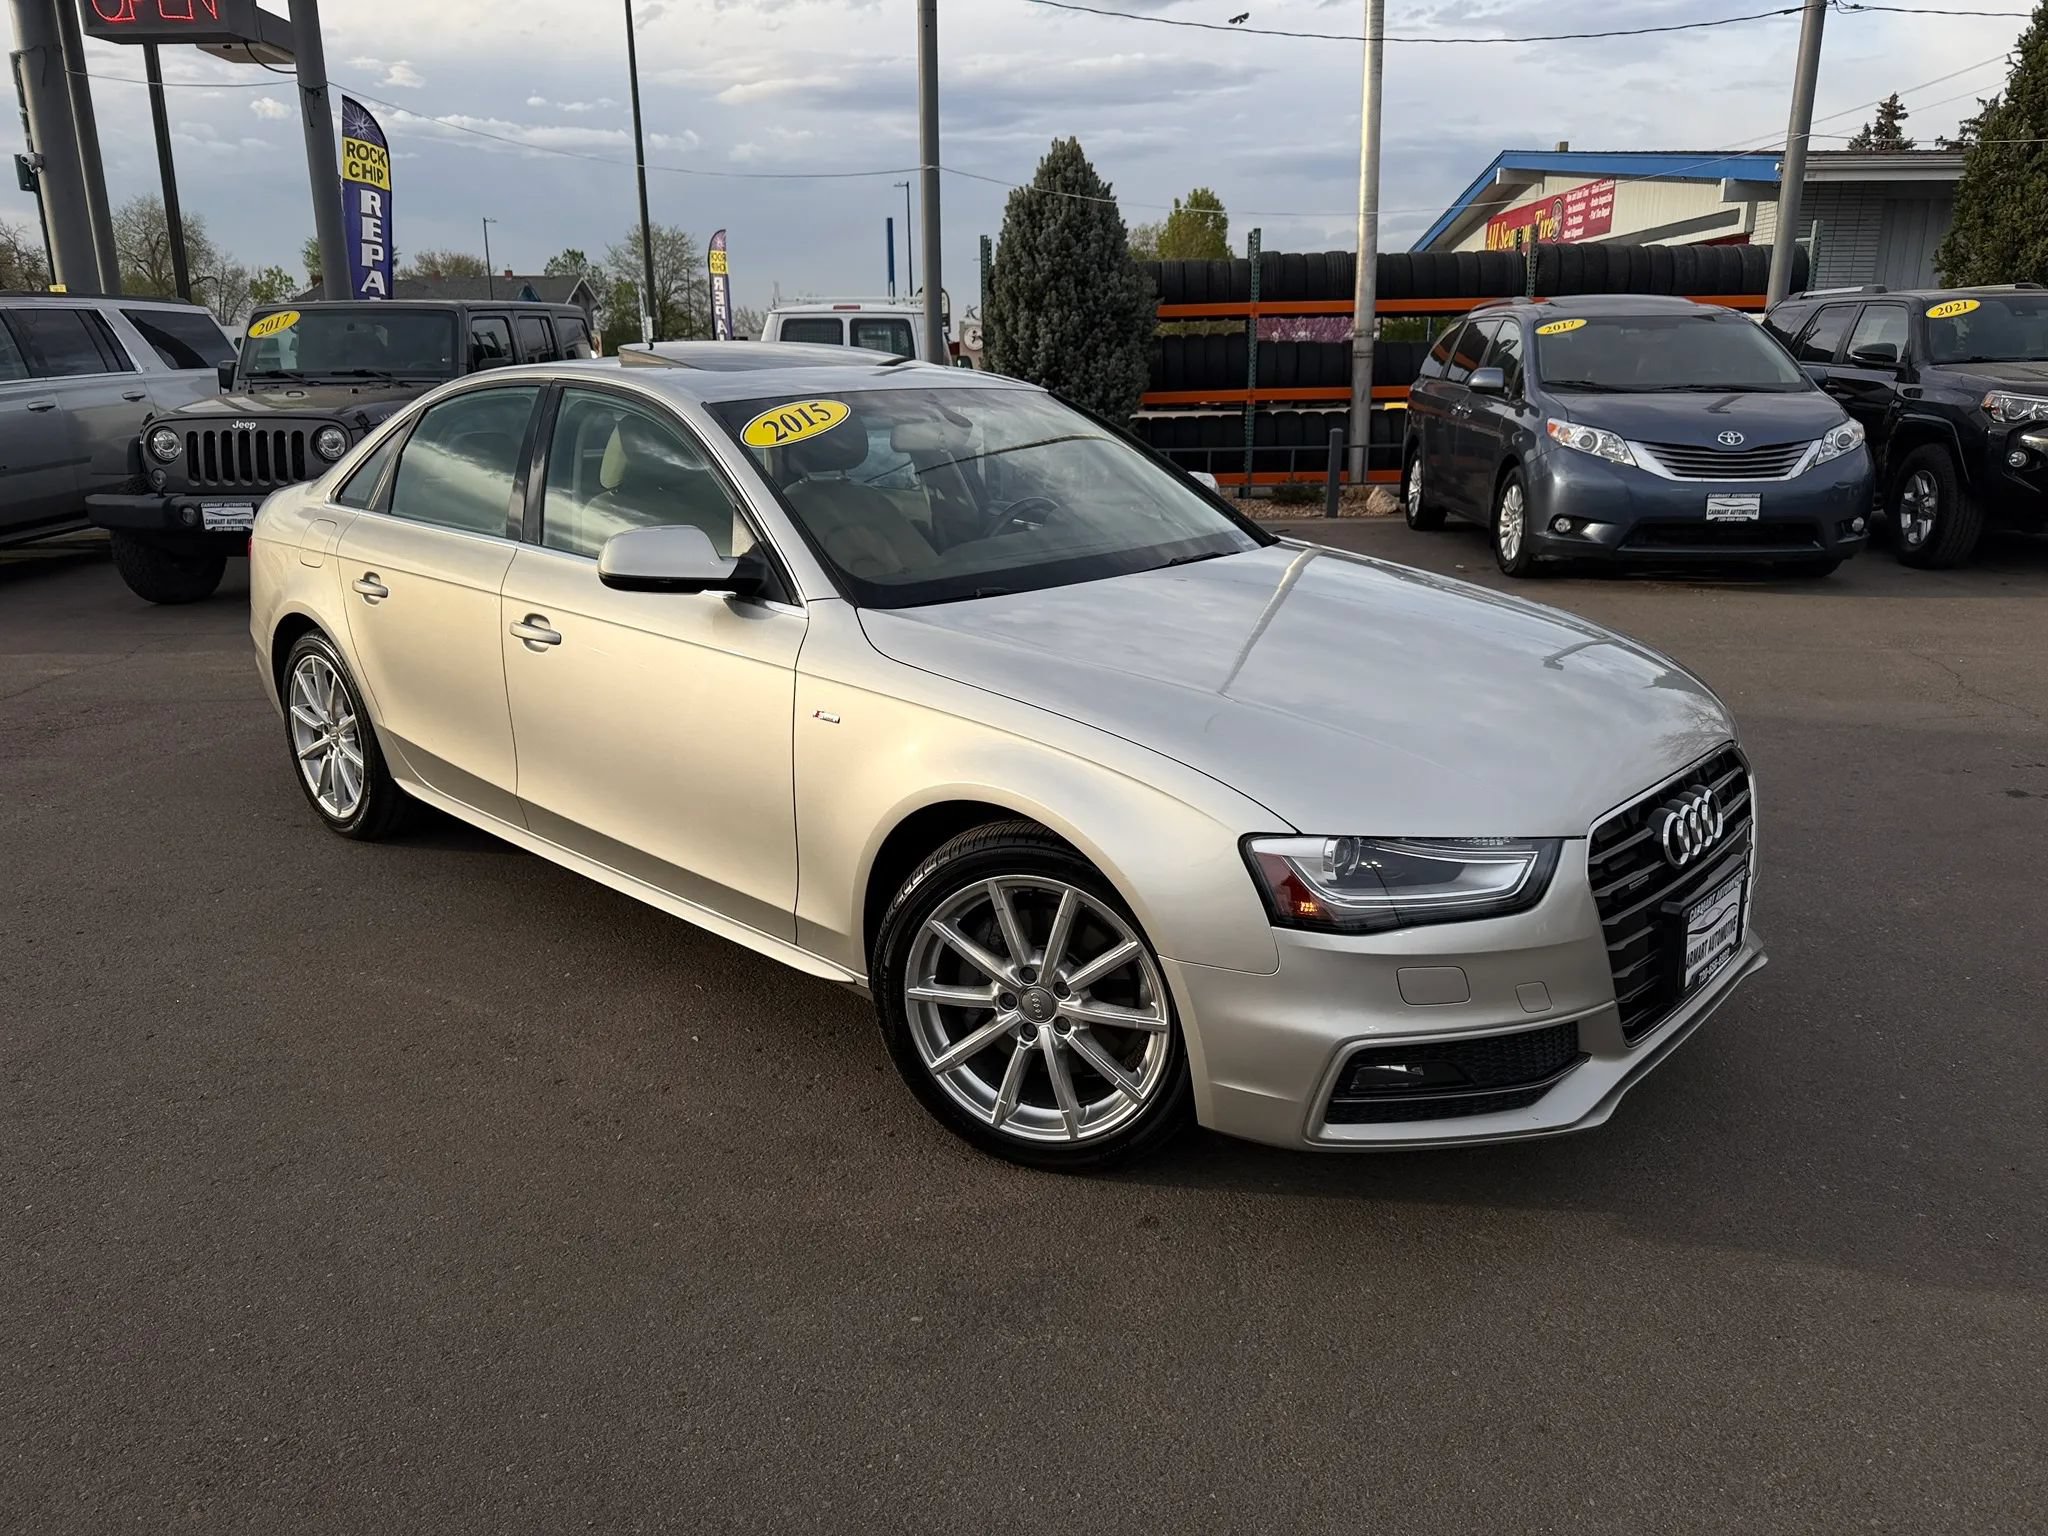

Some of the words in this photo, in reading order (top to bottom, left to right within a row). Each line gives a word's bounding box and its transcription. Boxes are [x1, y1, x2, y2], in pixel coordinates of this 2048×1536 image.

[345, 140, 387, 169] ROCK
[348, 161, 384, 185] CHIP
[1487, 222, 1500, 251] All
[1499, 221, 1532, 249] Seaon
[1937, 301, 1968, 317] 2021
[256, 313, 290, 337] 2017
[1544, 320, 1575, 333] 2017
[232, 420, 257, 430] Jeep
[762, 402, 832, 442] 2015
